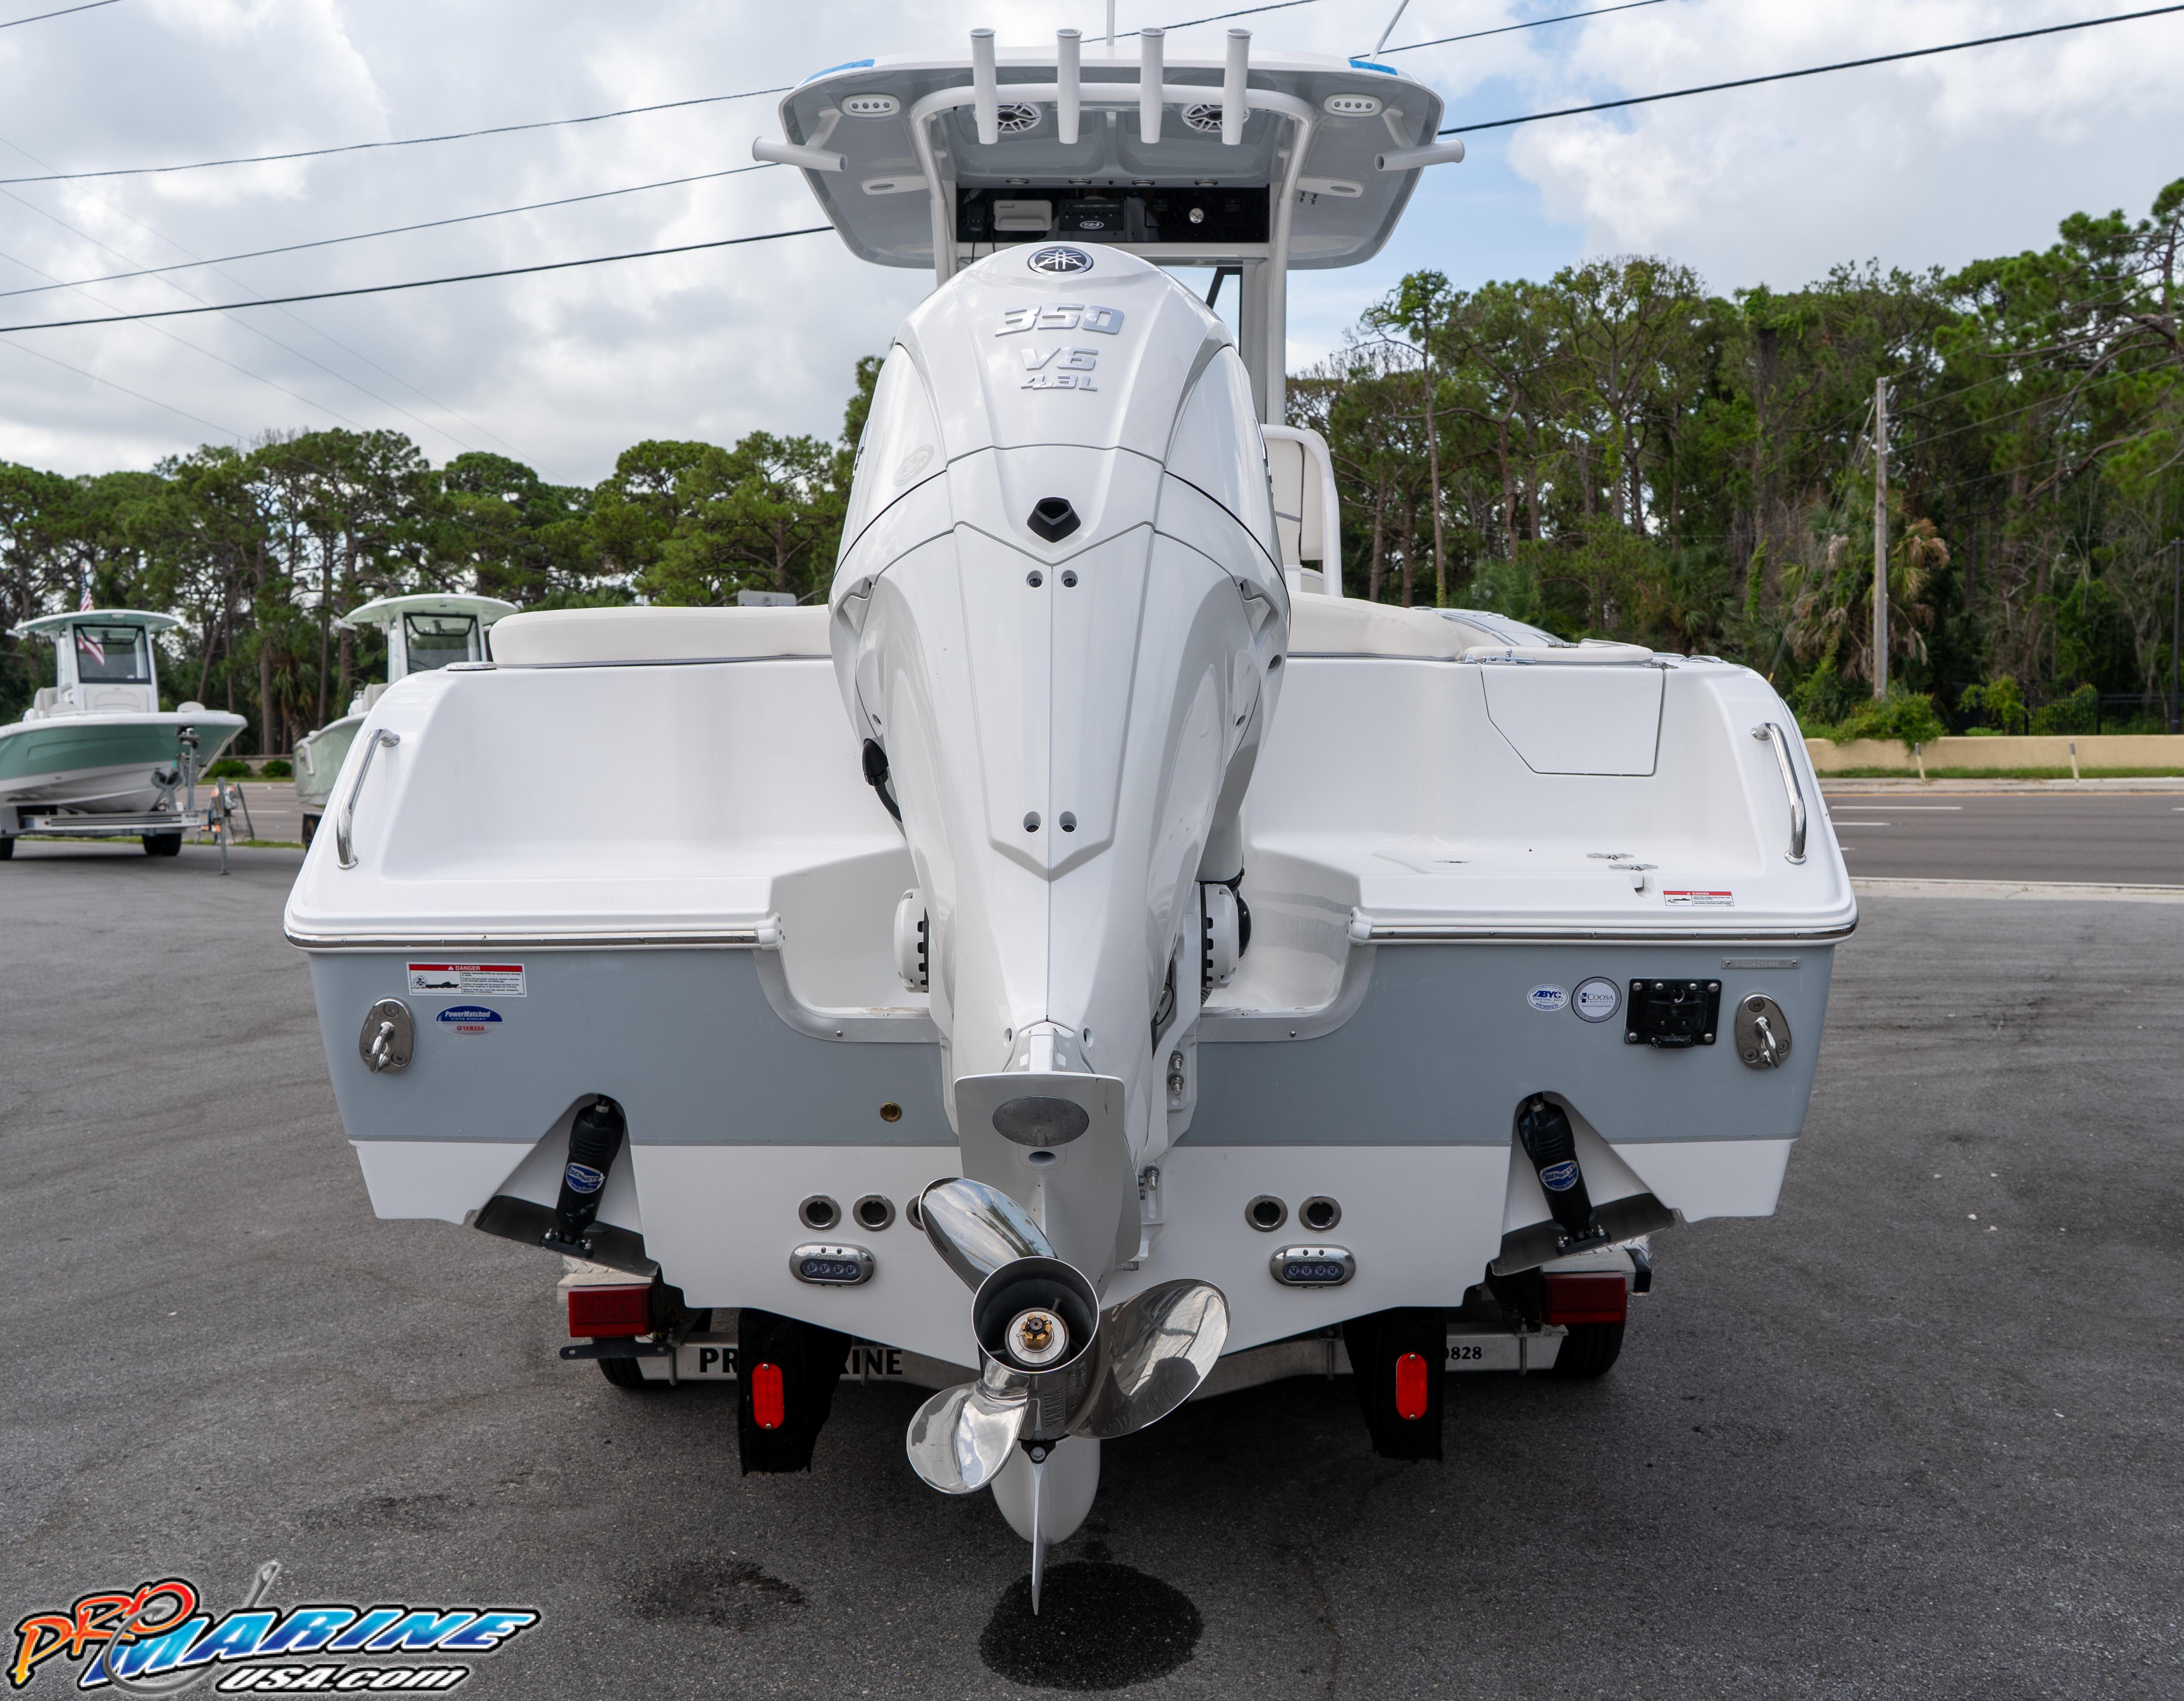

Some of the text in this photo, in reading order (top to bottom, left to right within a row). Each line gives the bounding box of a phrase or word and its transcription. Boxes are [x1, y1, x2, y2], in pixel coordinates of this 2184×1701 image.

[995, 303, 1124, 336] 350
[1021, 347, 1098, 371] V6
[700, 1348, 738, 1373] PR
[1446, 1346, 1482, 1360] 828
[1044, 1387, 1065, 1427] YAMAHA
